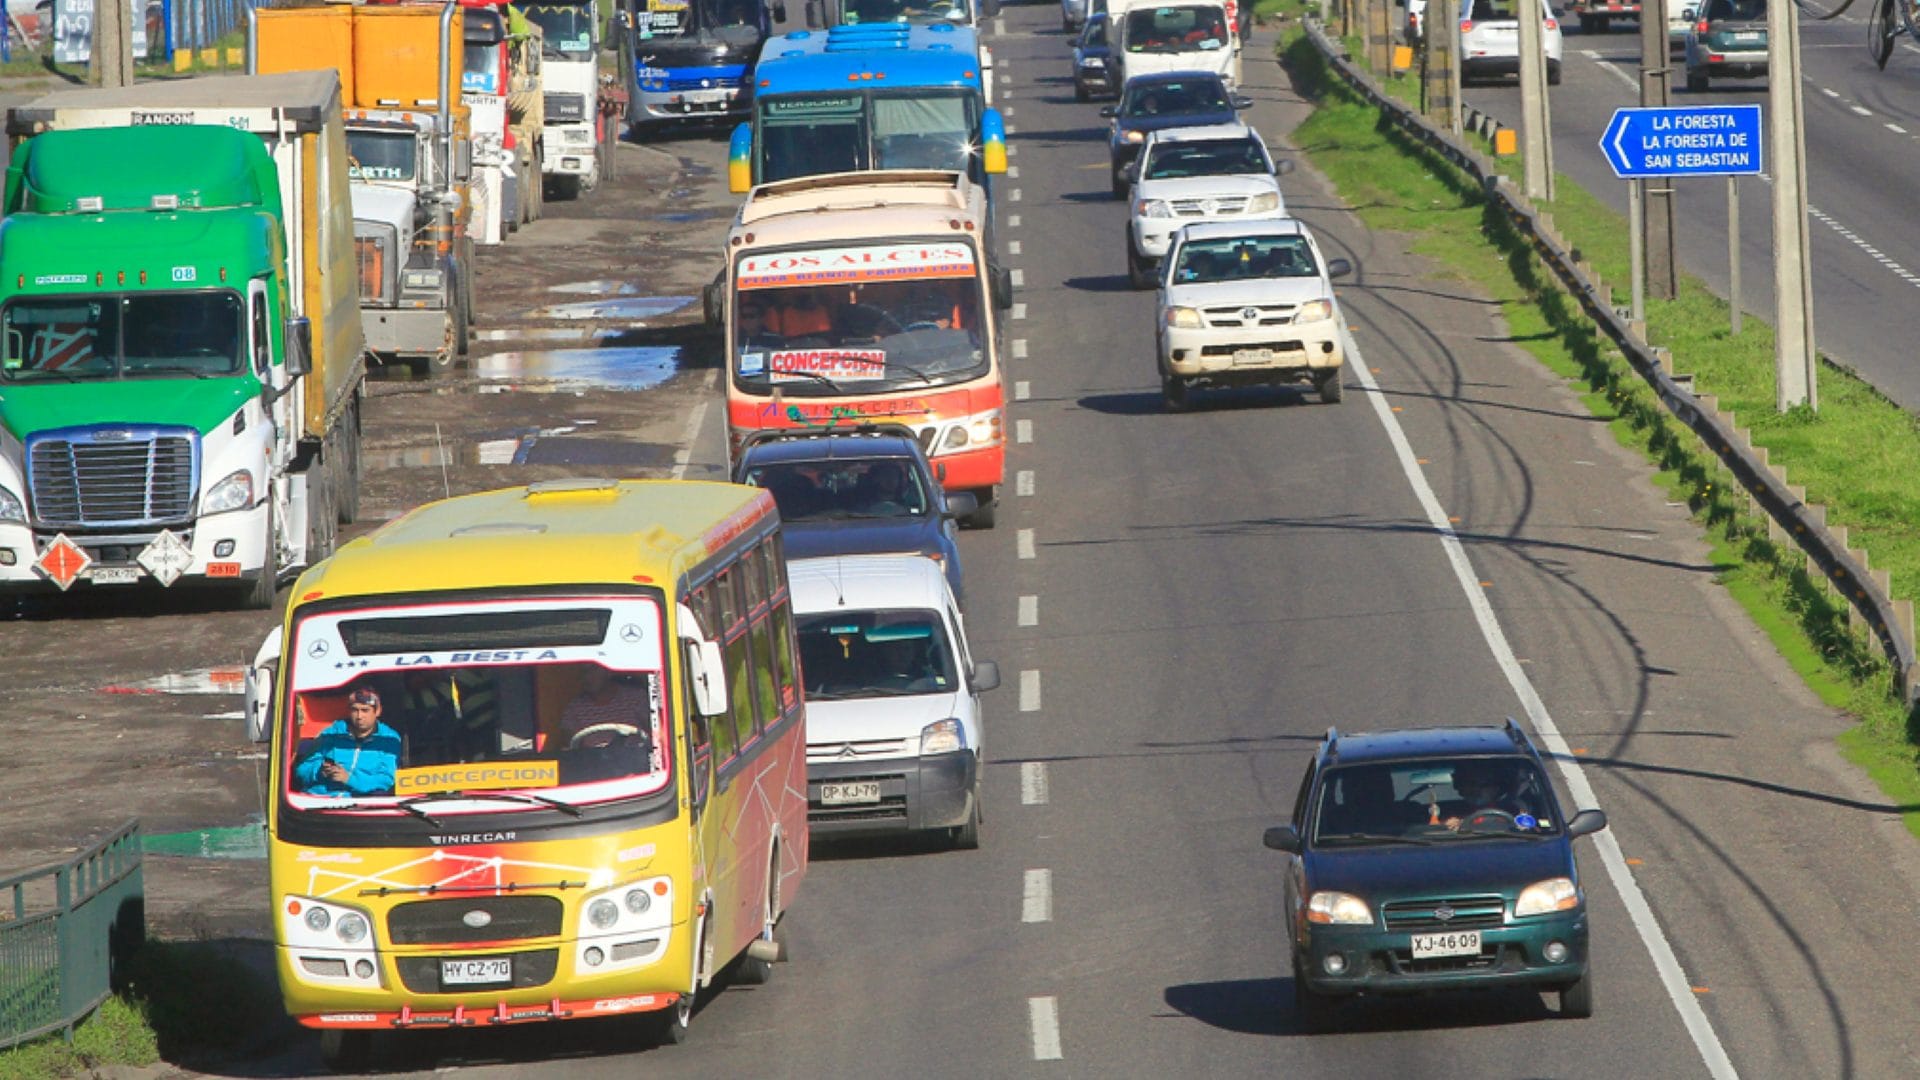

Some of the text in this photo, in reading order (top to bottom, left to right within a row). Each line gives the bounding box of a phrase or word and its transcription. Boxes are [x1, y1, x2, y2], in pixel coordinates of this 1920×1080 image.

[133, 114, 192, 125] RANDON
[1652, 114, 1736, 130] LA FORESTA
[1642, 133, 1748, 150] LA FORESTA DE
[1645, 152, 1749, 168] SAN SEBASTIAN
[747, 248, 965, 273] LOS ALCES
[174, 268, 194, 280] 08
[772, 350, 884, 372] CONCEPCION
[395, 655, 433, 666] LA
[399, 767, 554, 788] CONCEPCION
[441, 832, 516, 845] INRECAR
